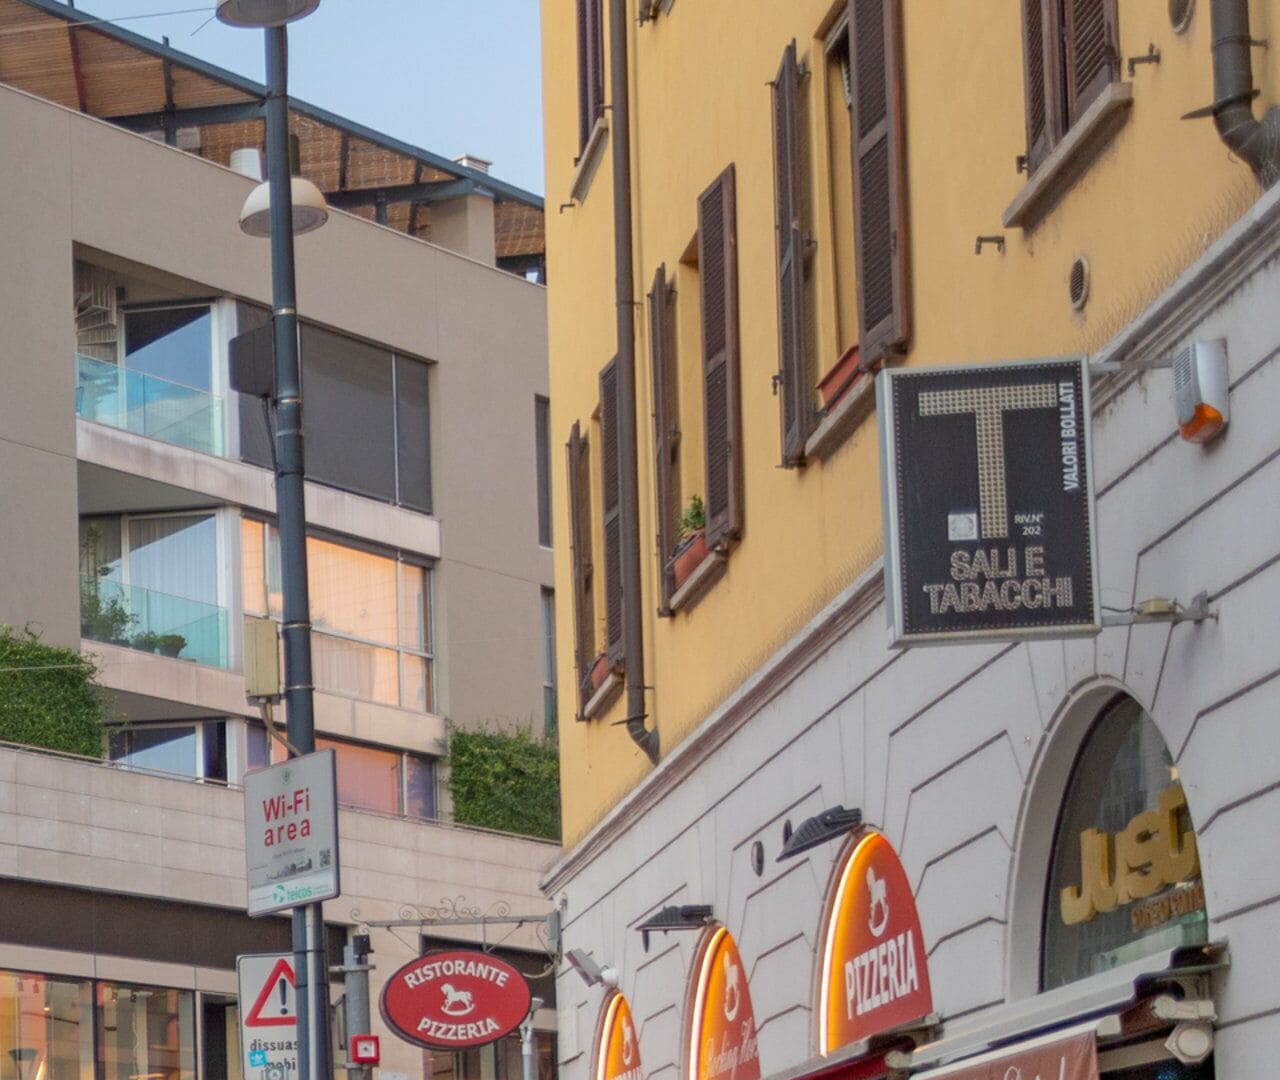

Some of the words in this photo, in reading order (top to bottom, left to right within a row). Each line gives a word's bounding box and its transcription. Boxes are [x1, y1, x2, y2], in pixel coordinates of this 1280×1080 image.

[1058, 381, 1077, 439] BOLLATI
[918, 383, 1058, 540] T
[1063, 442, 1079, 491] VALORI
[1022, 525, 1041, 536] 202
[950, 546, 1017, 581] SALI
[1024, 546, 1045, 578] E
[922, 577, 1074, 615] TABACCHI
[262, 788, 311, 823] Wi-Fi
[264, 819, 311, 847] area
[403, 959, 510, 989] RISTORANTE
[843, 929, 919, 1022] PIZZERIA
[416, 1017, 499, 1041] PIZZERIA
